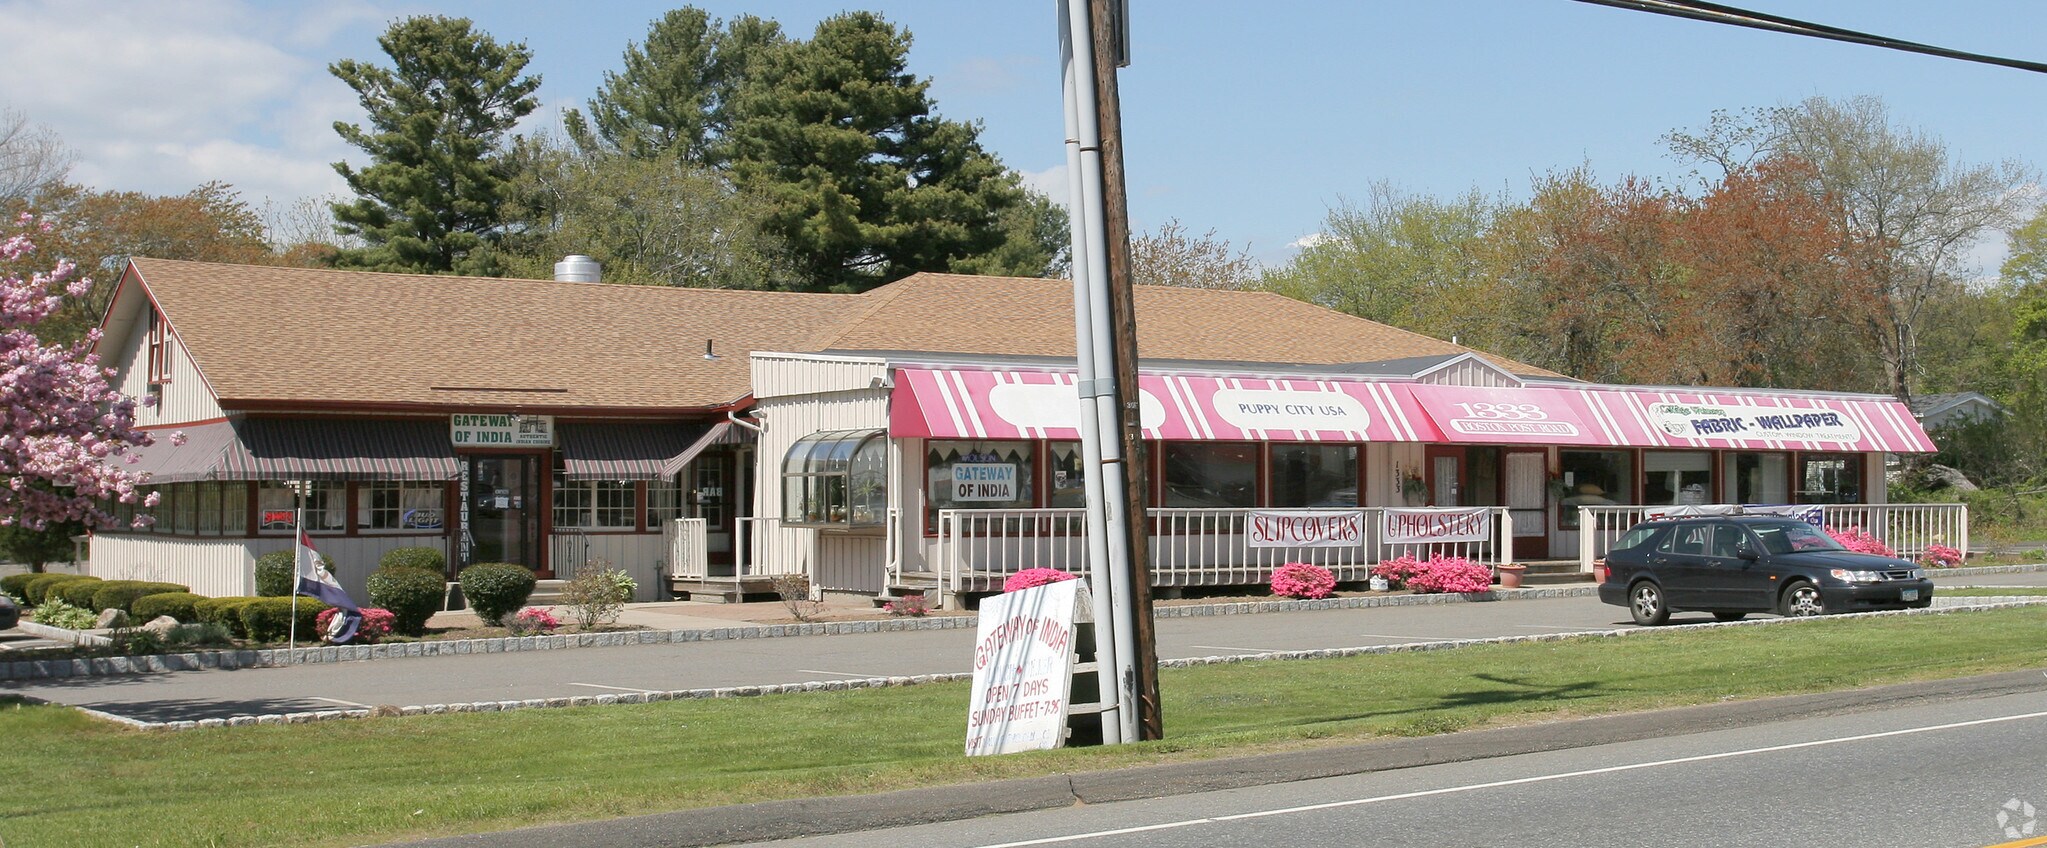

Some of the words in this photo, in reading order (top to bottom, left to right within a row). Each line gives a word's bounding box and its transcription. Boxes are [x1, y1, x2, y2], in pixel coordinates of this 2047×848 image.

[1238, 403, 1280, 415] PUPPY
[1285, 404, 1315, 415] CITY
[1318, 405, 1347, 416] USA
[1453, 402, 1548, 420] 1333
[453, 415, 512, 427] GATEWAY
[1461, 421, 1507, 432] BOSTON
[1508, 423, 1537, 433] POST
[1538, 424, 1572, 434] ROAD
[1690, 417, 1748, 435] FABRIC
[1754, 412, 1844, 431] WALLPAPER
[455, 431, 471, 442] OF
[477, 431, 512, 443] INDIA
[955, 466, 1012, 480] GATEWAY
[958, 483, 974, 498] OF
[978, 483, 1010, 498] INDIA
[460, 461, 469, 562] RESTAURANT
[1252, 515, 1359, 542] SLIPCOVERS
[1387, 512, 1485, 538] UPHOLSTERY
[976, 614, 1026, 670] GATEWAY
[1039, 616, 1068, 660] INDIA
[986, 685, 1010, 704] OPEN
[1012, 683, 1020, 700] 7
[1024, 679, 1049, 697] DAYS
[972, 706, 1007, 728] SUNDAY
[967, 736, 984, 750] VISIT
